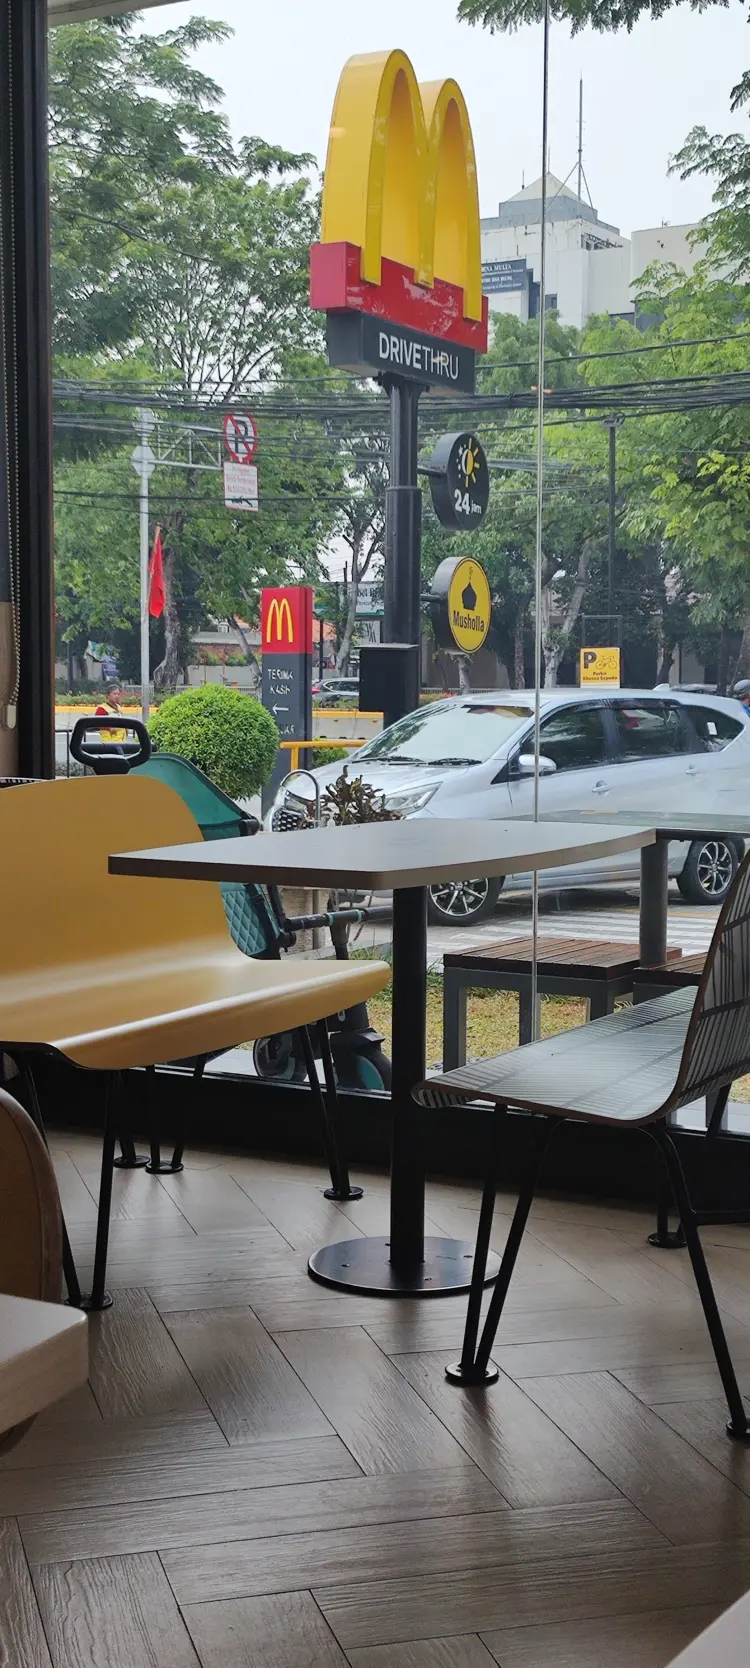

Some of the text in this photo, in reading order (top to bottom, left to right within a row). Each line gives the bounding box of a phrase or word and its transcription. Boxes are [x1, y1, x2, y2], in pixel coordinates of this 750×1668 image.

[454, 488, 482, 516] 24 jam
[453, 609, 485, 633] Musholla
[583, 651, 597, 669] P
[267, 668, 294, 680] TERIMA
